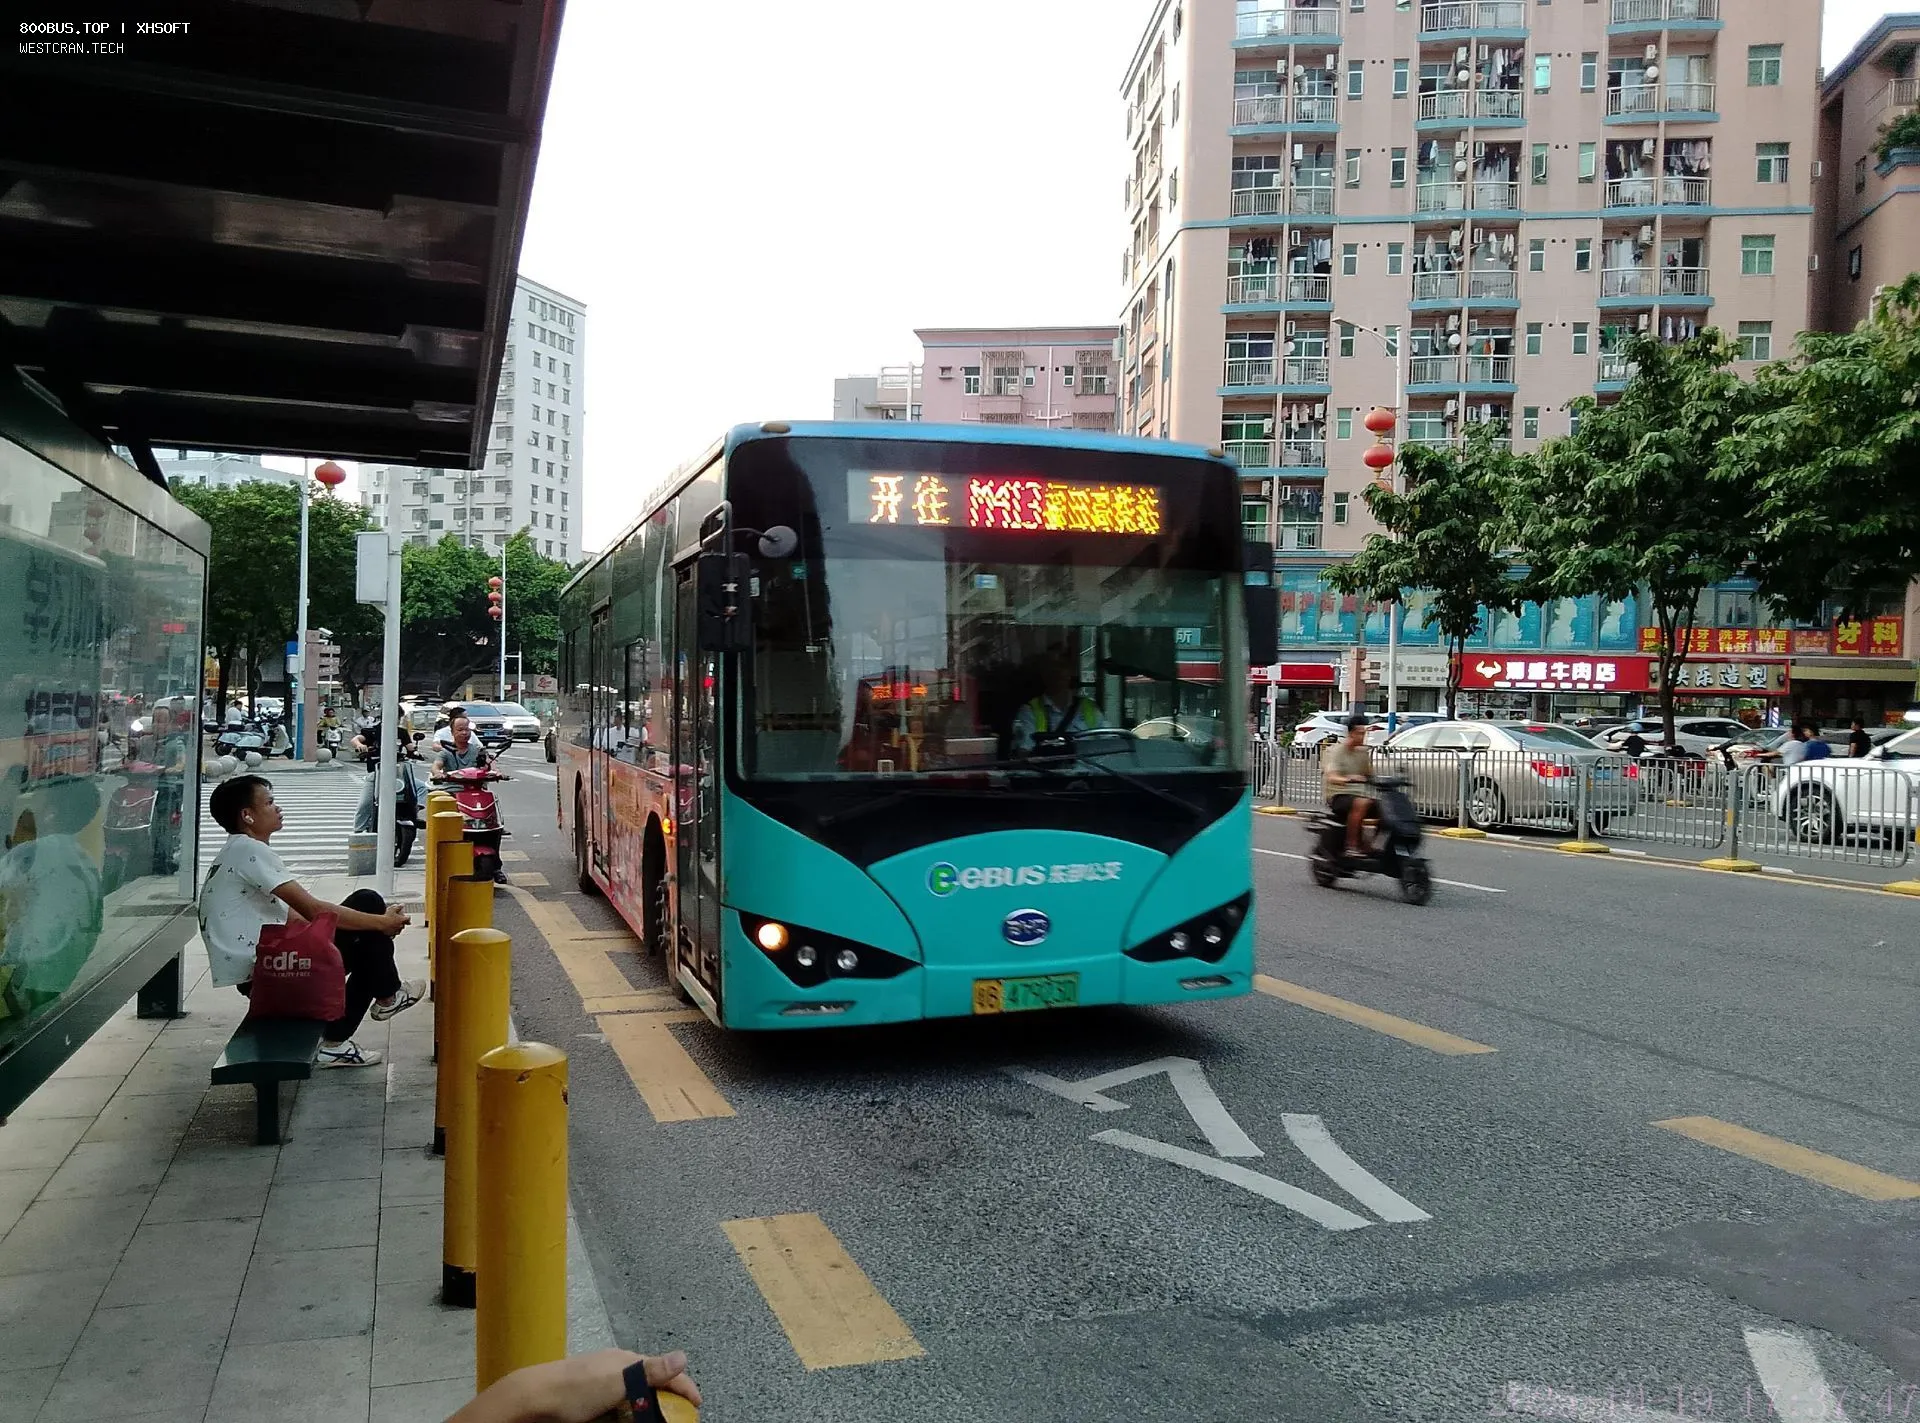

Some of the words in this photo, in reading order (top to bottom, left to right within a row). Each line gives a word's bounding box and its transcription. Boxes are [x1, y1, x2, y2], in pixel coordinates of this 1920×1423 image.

[868, 475, 951, 525] 开往
[968, 477, 1044, 530] M413
[1837, 621, 1897, 645] 牙科
[263, 951, 298, 970] cdf
